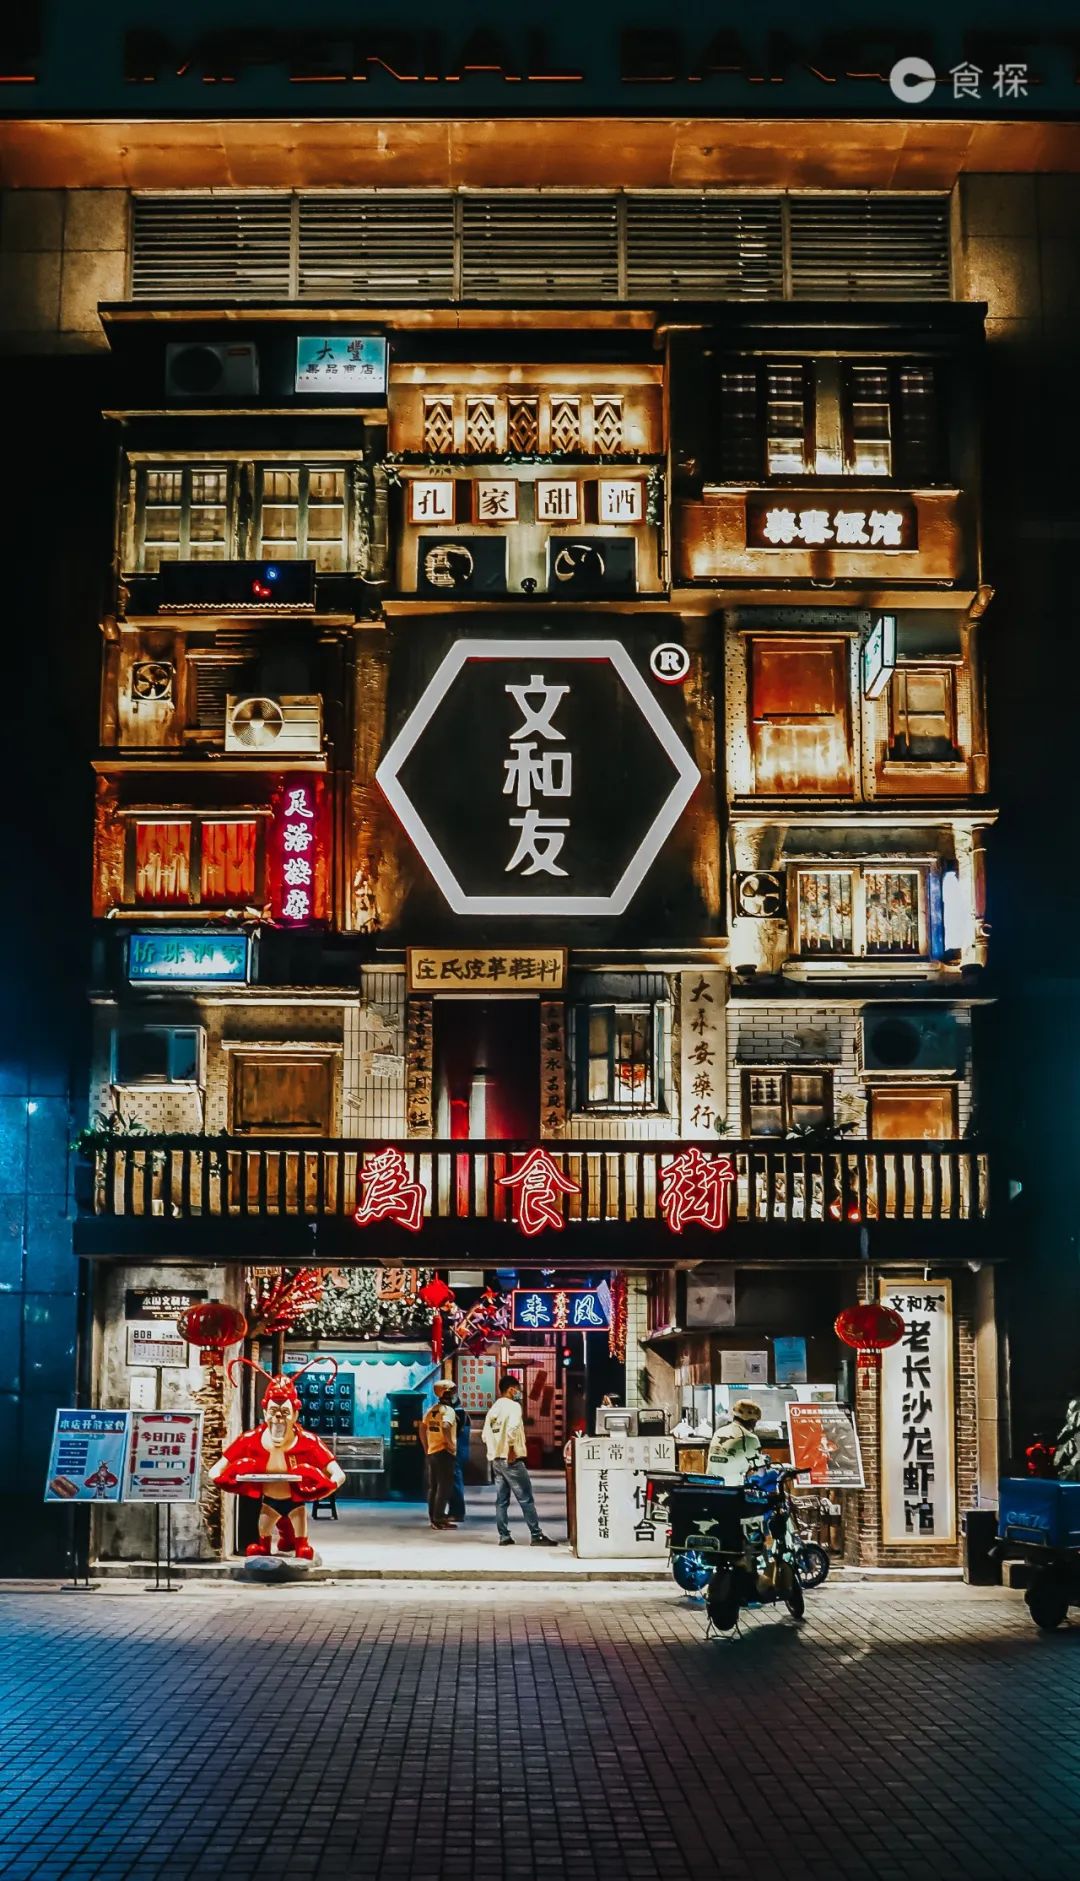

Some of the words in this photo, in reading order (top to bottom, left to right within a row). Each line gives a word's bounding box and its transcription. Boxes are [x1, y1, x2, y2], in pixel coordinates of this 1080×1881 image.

[502, 674, 573, 877] 文和友
[889, 1295, 939, 1313] 文和友
[141, 1432, 187, 1444] 今日门店
[901, 1319, 935, 1536] 老长沙龙虾馆
